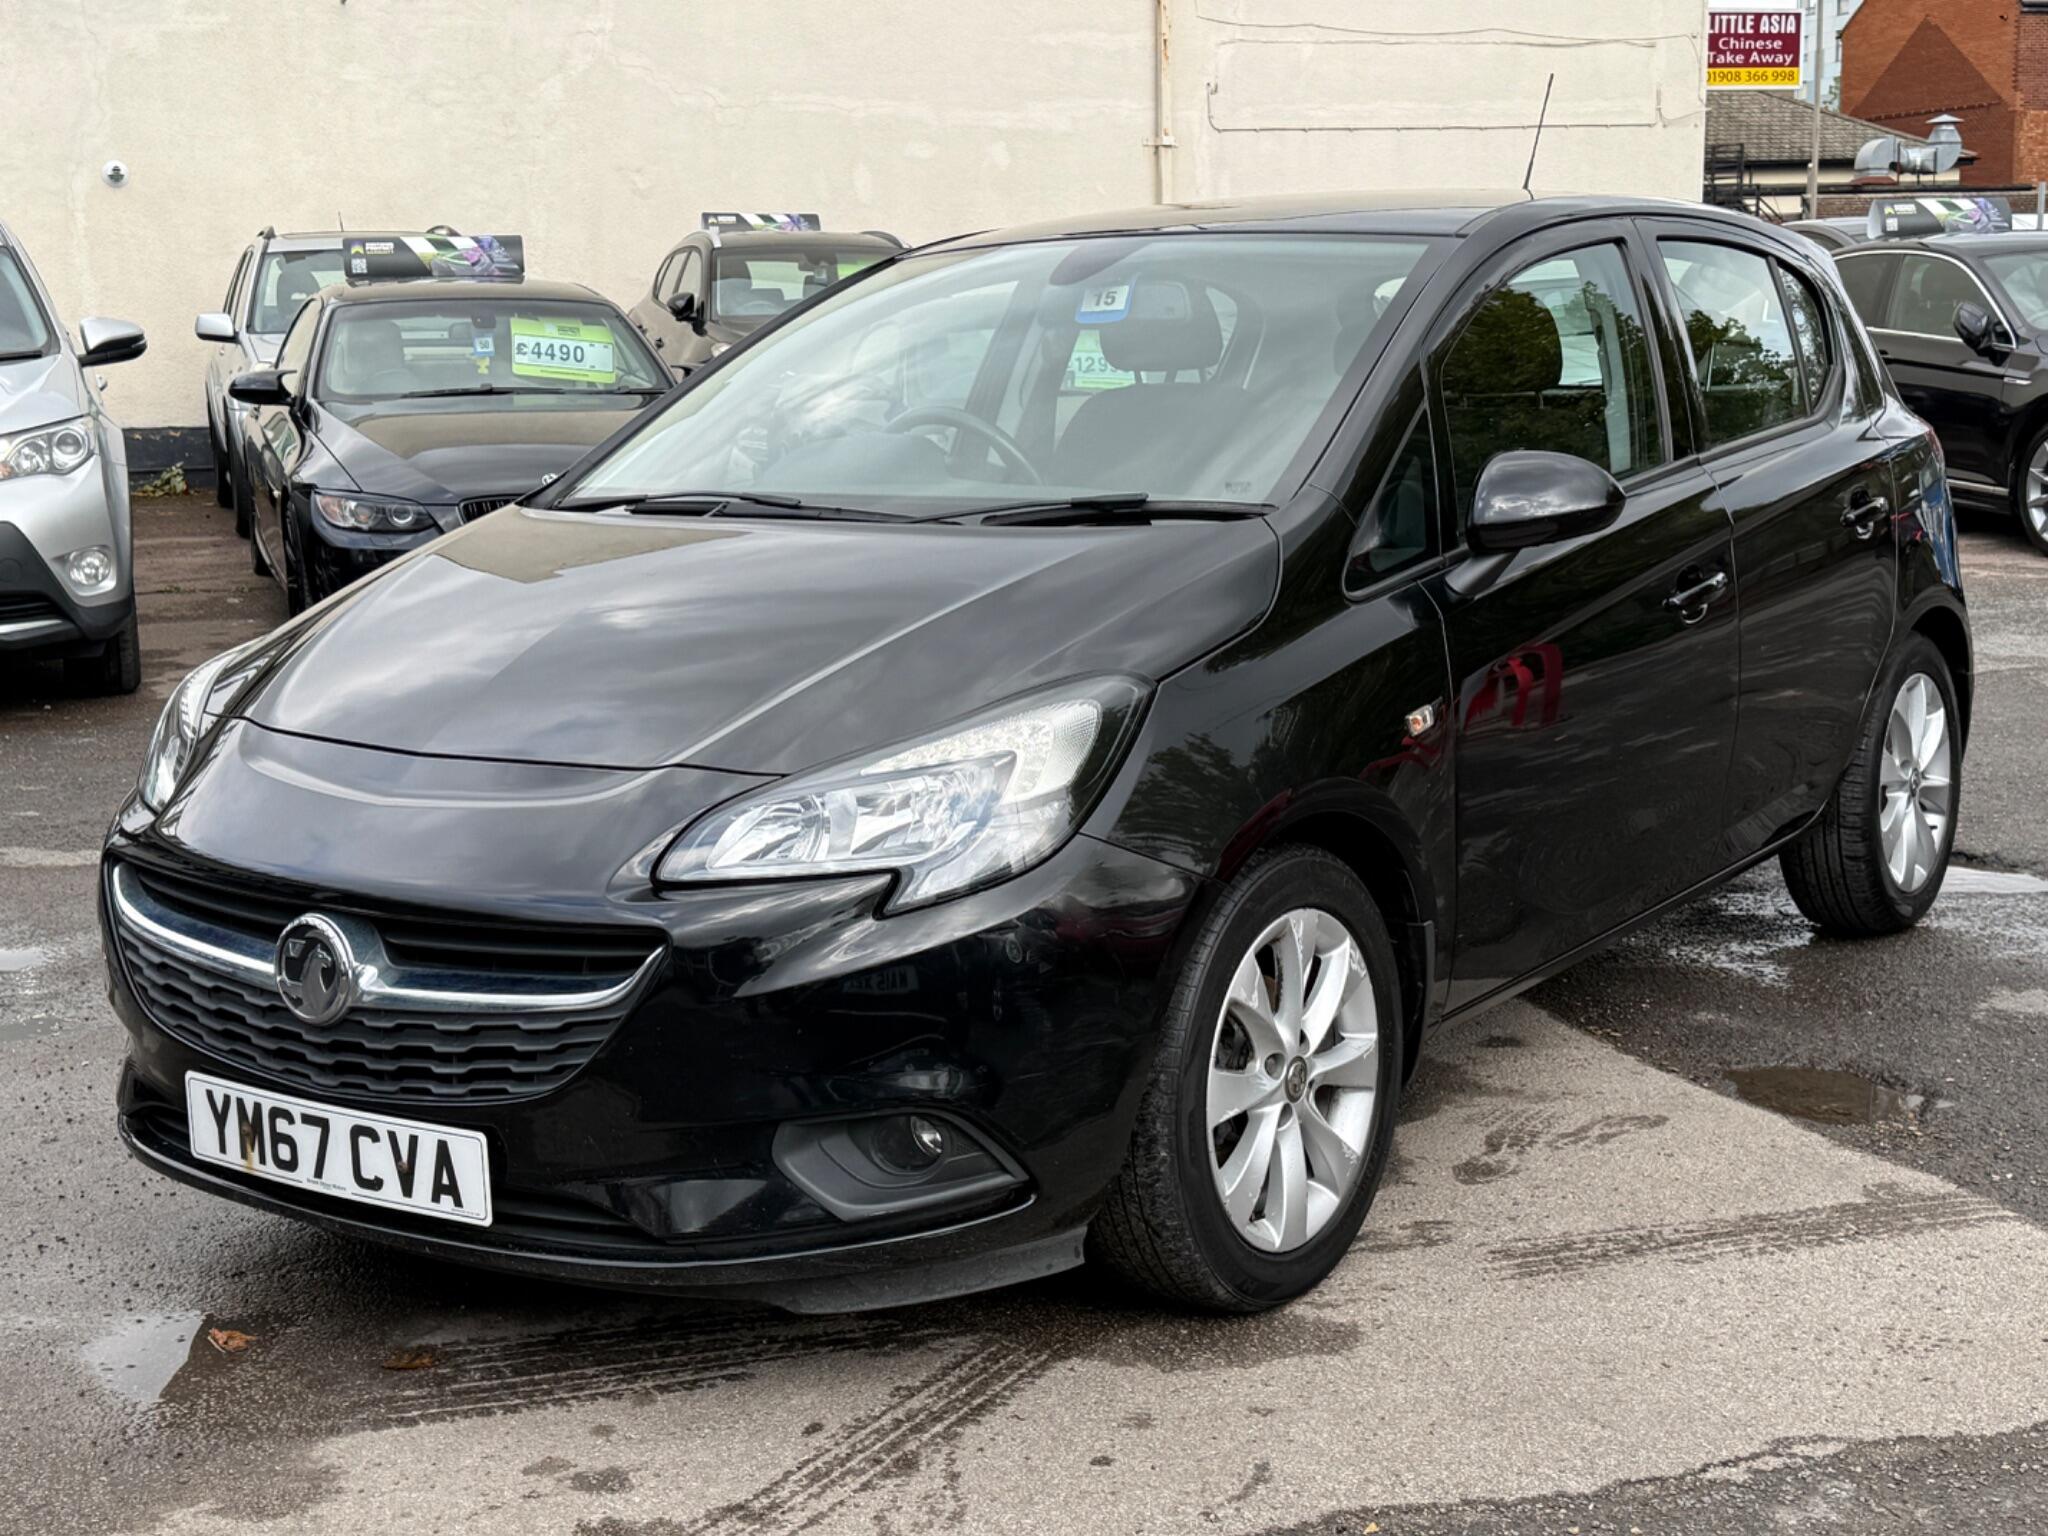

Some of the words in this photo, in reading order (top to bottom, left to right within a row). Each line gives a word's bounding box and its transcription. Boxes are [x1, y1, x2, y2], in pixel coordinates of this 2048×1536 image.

[1708, 14, 1754, 34] LITTLE
[1760, 14, 1796, 34] ASIA
[1718, 37, 1783, 50] Chinese
[1708, 51, 1745, 64] Take
[1749, 51, 1794, 66] Away
[1745, 71, 1768, 82] 366
[1771, 70, 1795, 81] 998
[1093, 290, 1118, 307] 15
[516, 342, 585, 363] £4490
[1074, 356, 1118, 373] 129
[205, 1089, 330, 1180] YM67
[350, 1123, 464, 1209] CVA
